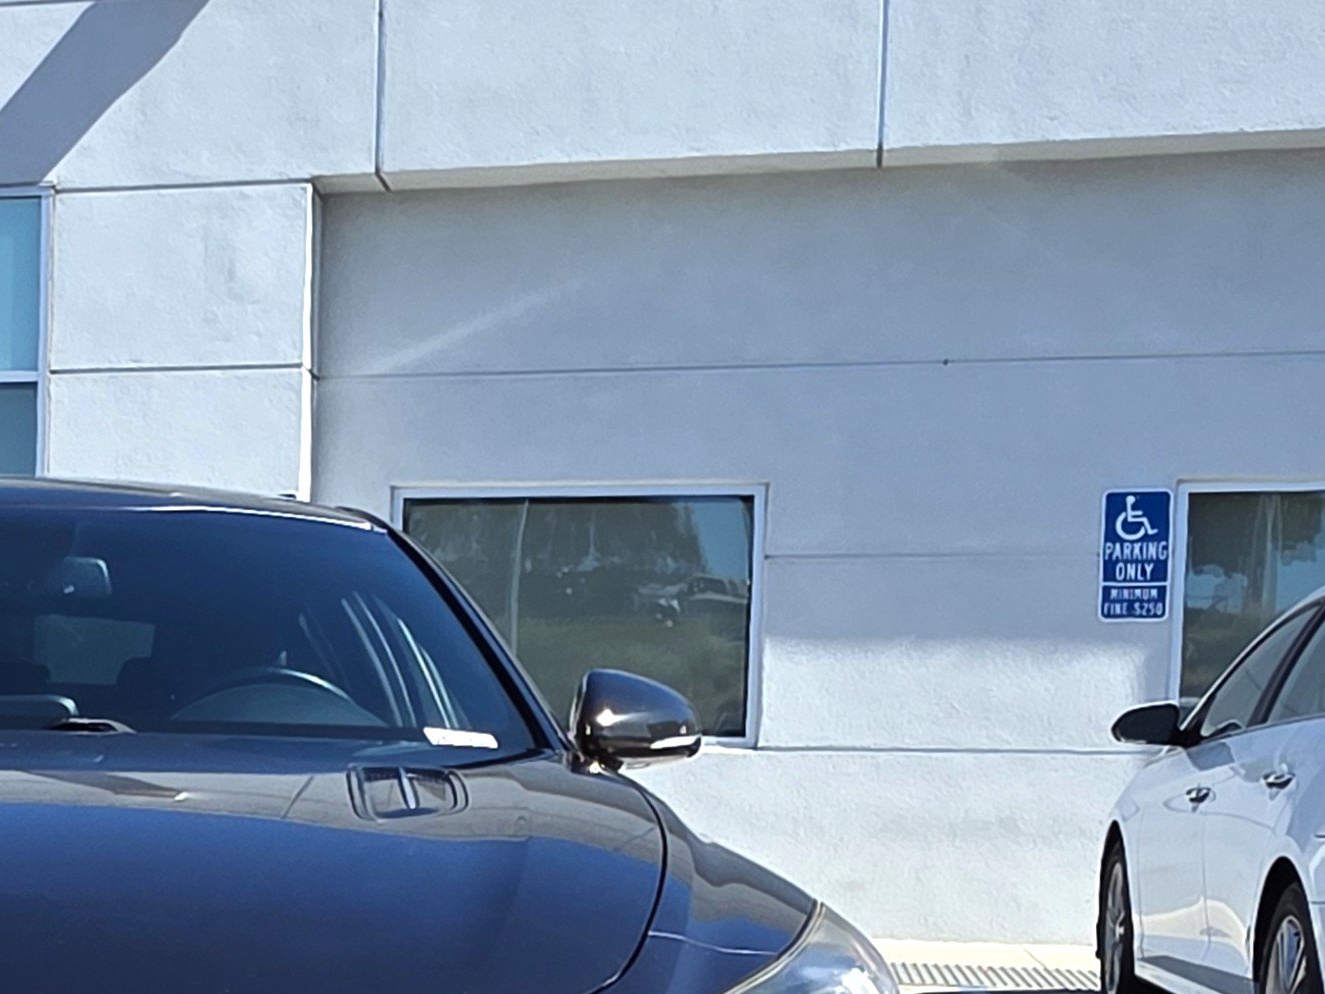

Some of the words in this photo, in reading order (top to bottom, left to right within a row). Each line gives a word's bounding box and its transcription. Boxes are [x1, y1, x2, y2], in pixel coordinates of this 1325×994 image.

[1104, 541, 1167, 560] PARKING
[1115, 562, 1154, 581] ONLY
[1111, 588, 1157, 600] MINIMUM
[1104, 602, 1127, 614] FINE
